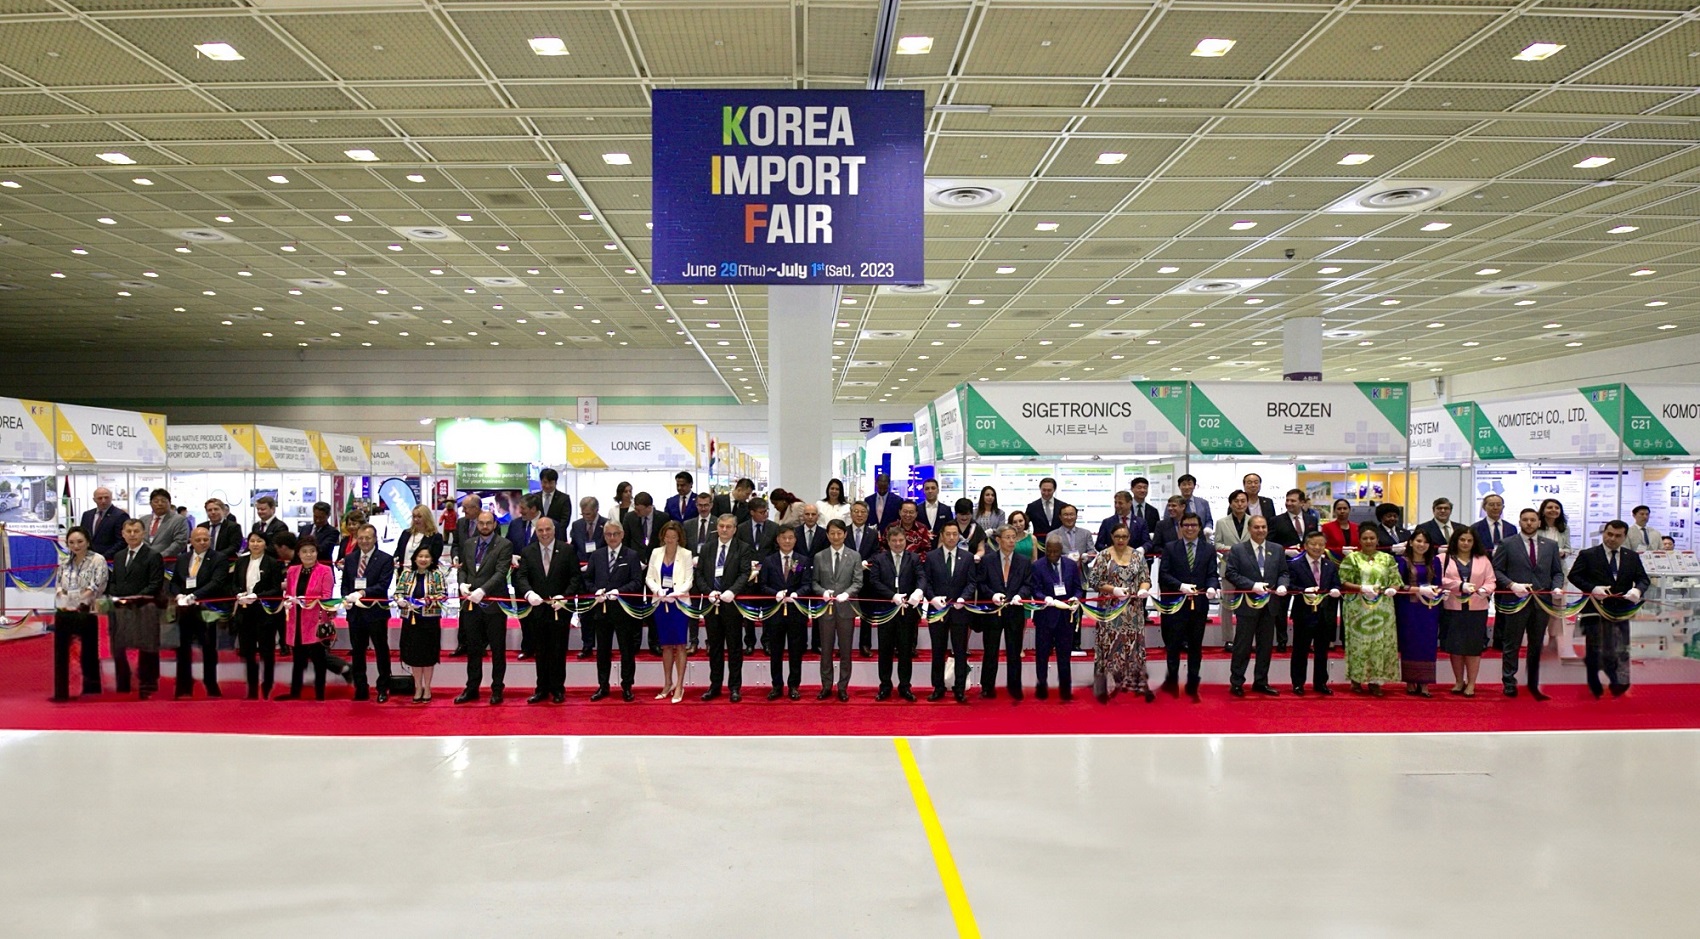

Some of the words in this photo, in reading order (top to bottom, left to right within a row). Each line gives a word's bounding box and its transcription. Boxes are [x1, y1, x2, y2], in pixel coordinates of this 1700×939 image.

[722, 105, 855, 146] KOREA
[711, 155, 866, 196] IMPORT
[745, 204, 833, 244] FAIR
[682, 263, 716, 277] June
[860, 262, 895, 278] 2023
[1021, 402, 1132, 418] SIGETRONICS
[1267, 402, 1332, 418] BROZEN
[1199, 418, 1220, 428] C02
[1498, 412, 1543, 428] KOMOTECH
[1546, 409, 1565, 425] CO.,
[1568, 407, 1588, 422] LTD.
[91, 423, 114, 436] DYNE
[117, 425, 137, 438] CELL
[975, 420, 996, 430] C01
[1045, 424, 1108, 436] 시지트로닉스
[1283, 424, 1315, 436] 브로젠
[1631, 420, 1651, 430] C21
[1479, 430, 1491, 439] C21
[1529, 430, 1551, 441] 코모텍
[611, 441, 651, 451] LOUNGE
[1410, 438, 1432, 448] 스시스템
